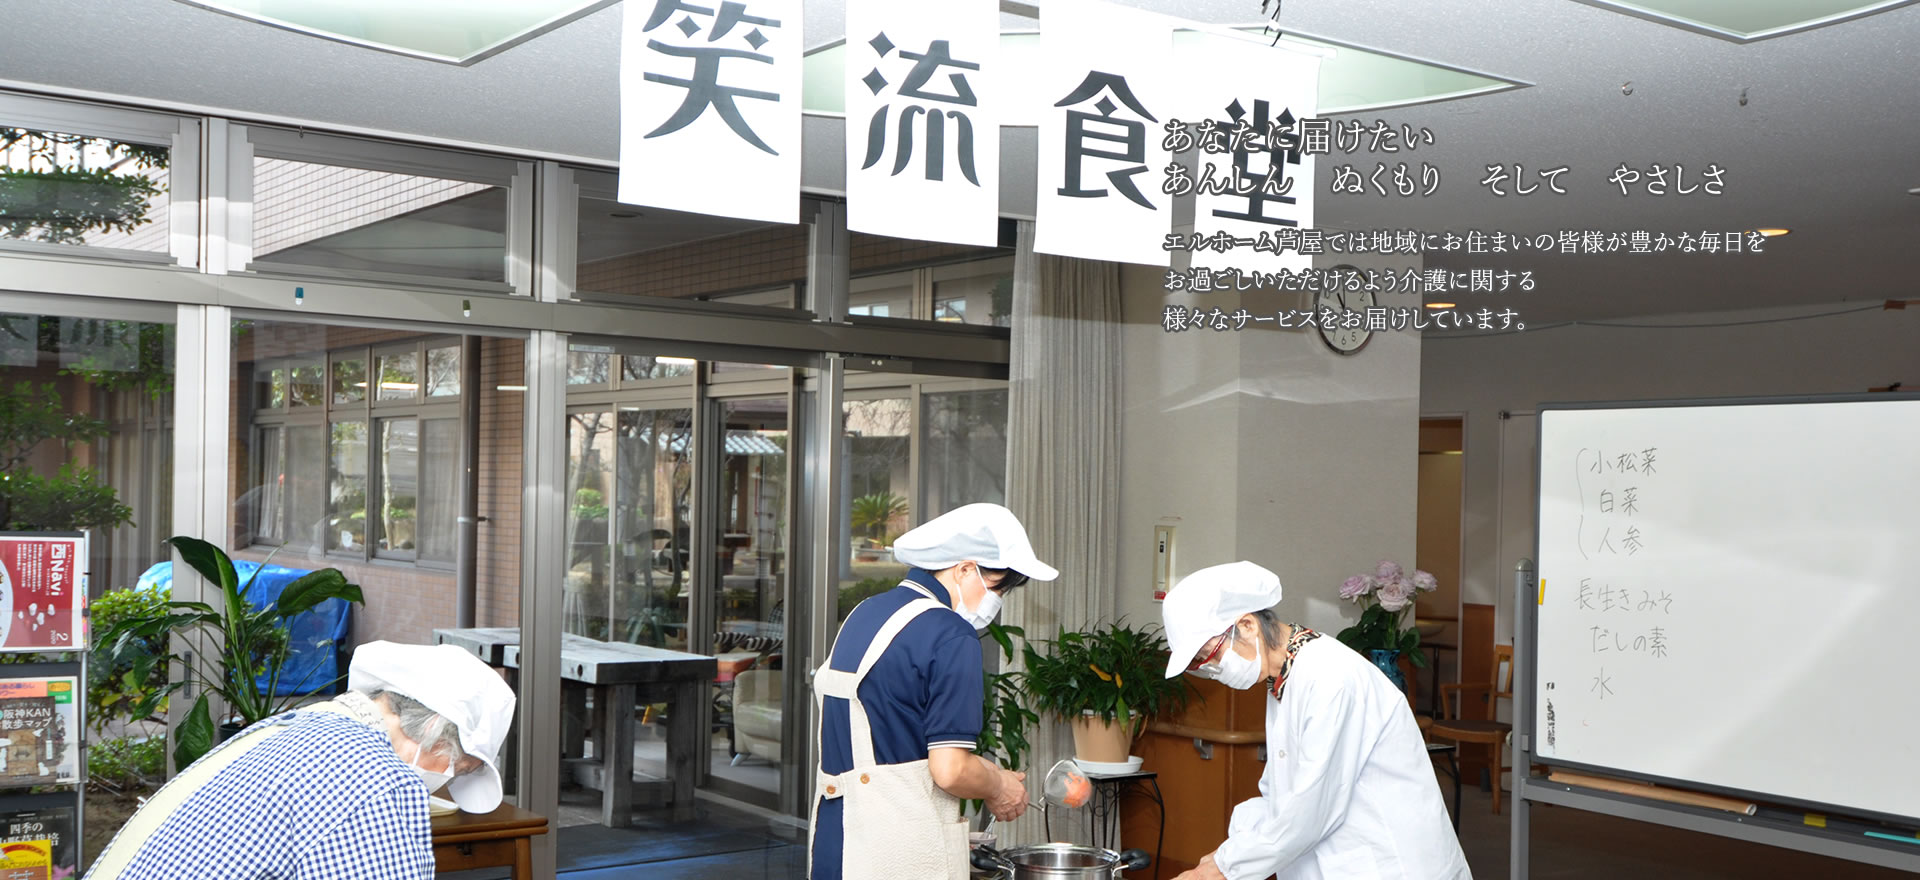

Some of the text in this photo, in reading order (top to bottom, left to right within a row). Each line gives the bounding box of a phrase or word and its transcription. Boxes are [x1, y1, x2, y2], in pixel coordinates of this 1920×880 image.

[1590, 447, 1657, 476] 小松菜
[1600, 487, 1639, 516] 白菜
[1598, 525, 1644, 555] 人参
[1573, 577, 1673, 614] 長生きみそ
[56, 632, 69, 641] 2
[1590, 626, 1668, 658] だしの素
[1591, 667, 1614, 700] 水
